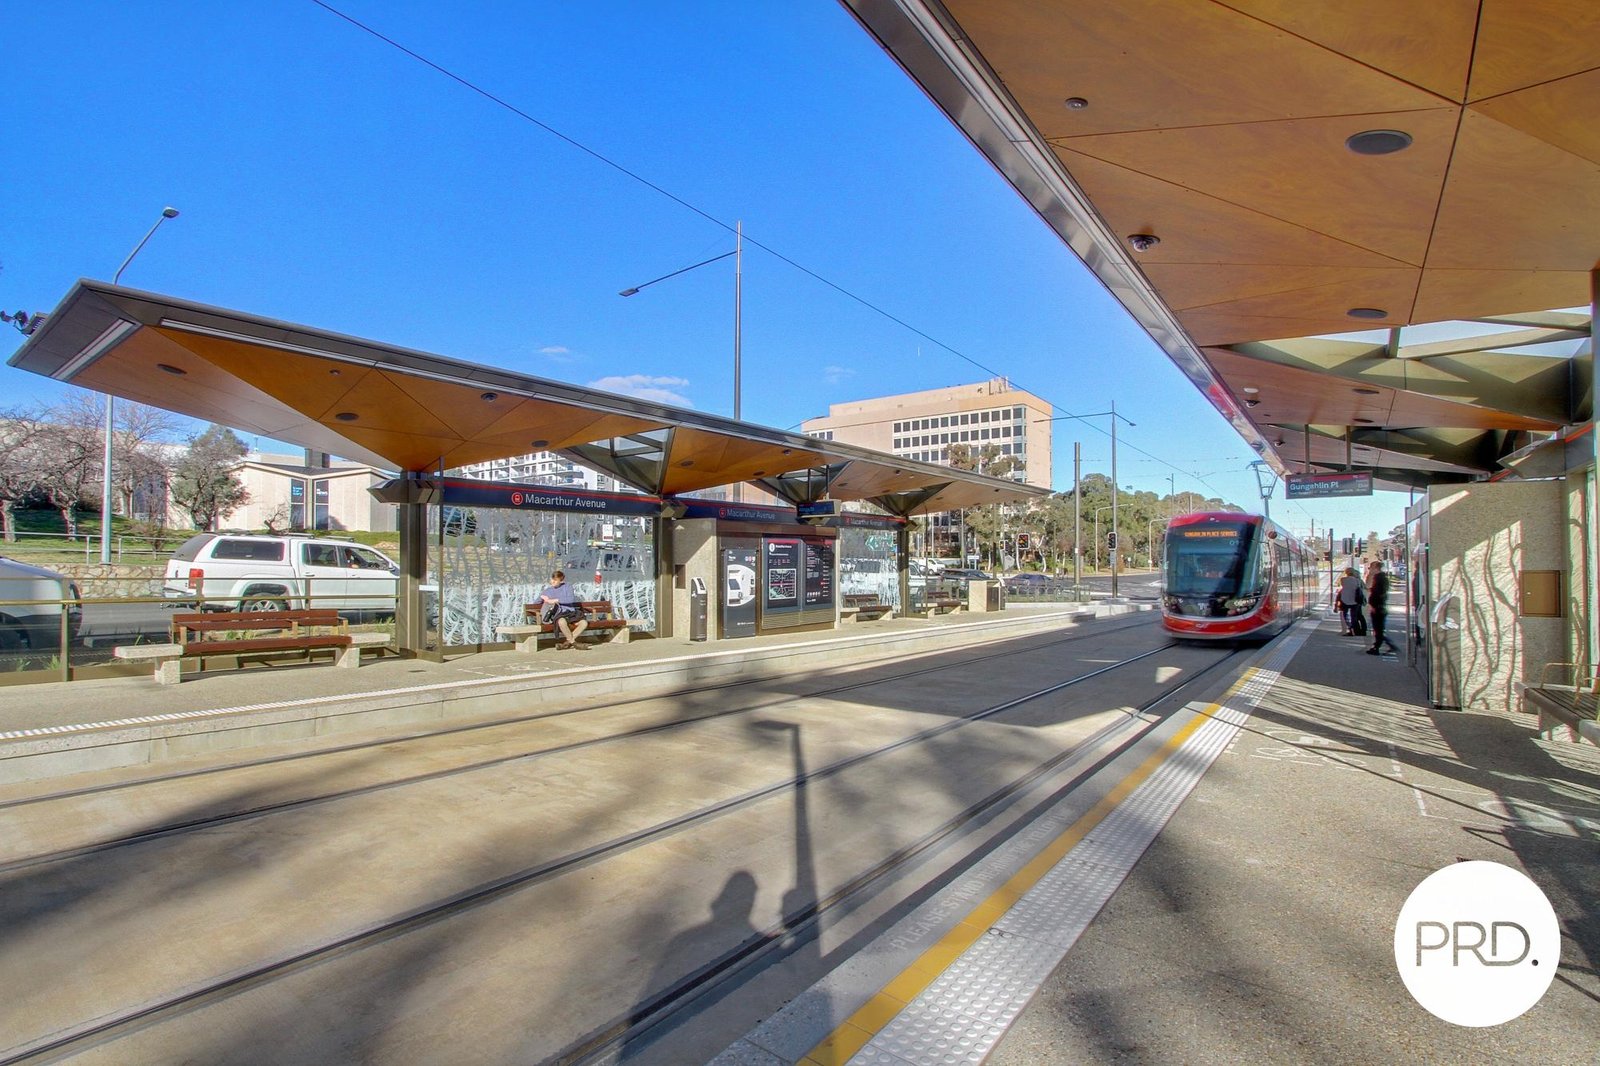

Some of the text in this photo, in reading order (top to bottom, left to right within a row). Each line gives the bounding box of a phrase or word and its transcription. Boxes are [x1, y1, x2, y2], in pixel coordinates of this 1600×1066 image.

[1289, 482, 1329, 491] Gungahlin
[525, 493, 607, 509] Macarthur Avenue
[727, 508, 775, 520] Macarthur Avenue
[890, 907, 946, 951] PLEASE
[941, 879, 985, 910] STAND
